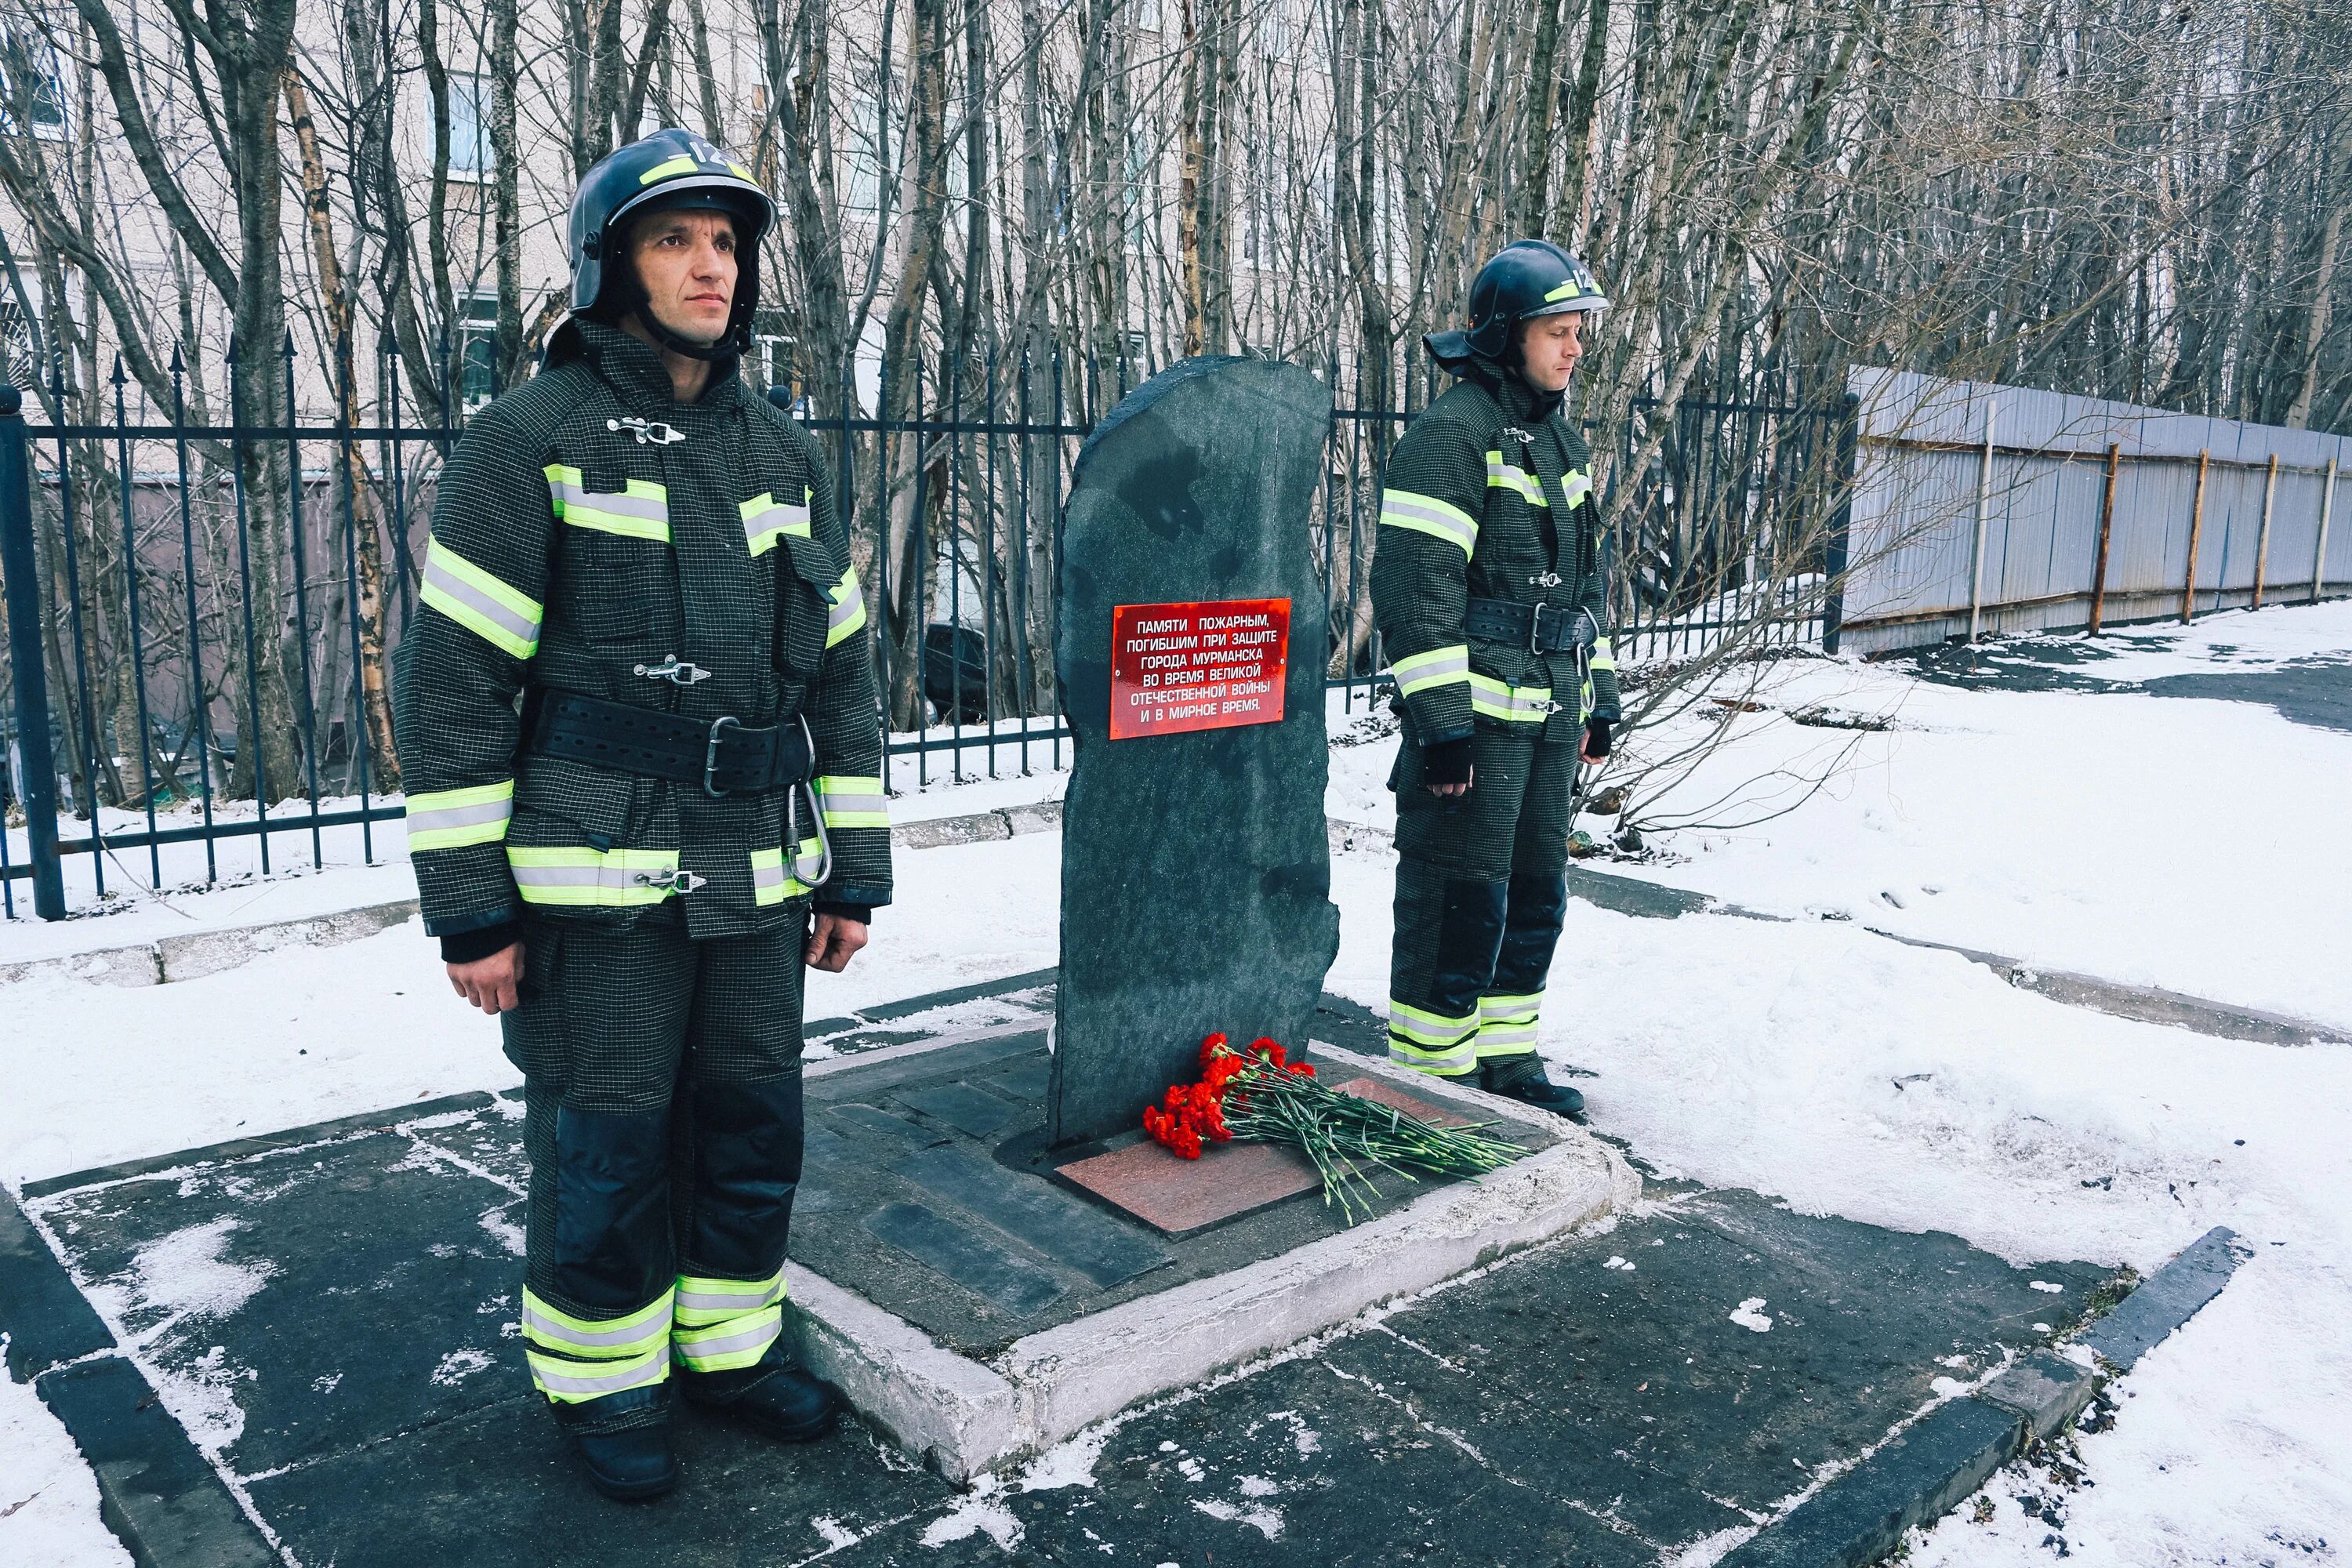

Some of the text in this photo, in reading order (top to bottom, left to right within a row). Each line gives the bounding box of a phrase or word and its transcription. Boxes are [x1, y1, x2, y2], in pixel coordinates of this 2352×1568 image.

[1137, 614, 1269, 634] ПАМЯТИ ПОЖАРНЫМ,
[1127, 630, 1277, 652] ПОГИБШИМ ПРИ ЗАЩИТЕ
[1141, 648, 1263, 670] ГОРОДА МУРМАНСКА
[1143, 662, 1261, 688] ВО ВРЕМЯ ВЕЛИКОЙ
[1131, 681, 1270, 706] ОТЕЧЕСТВЕННОЙ ВОЙНЫ
[1141, 699, 1260, 723] И В МИРНОЕ ВРЕМЯ.
